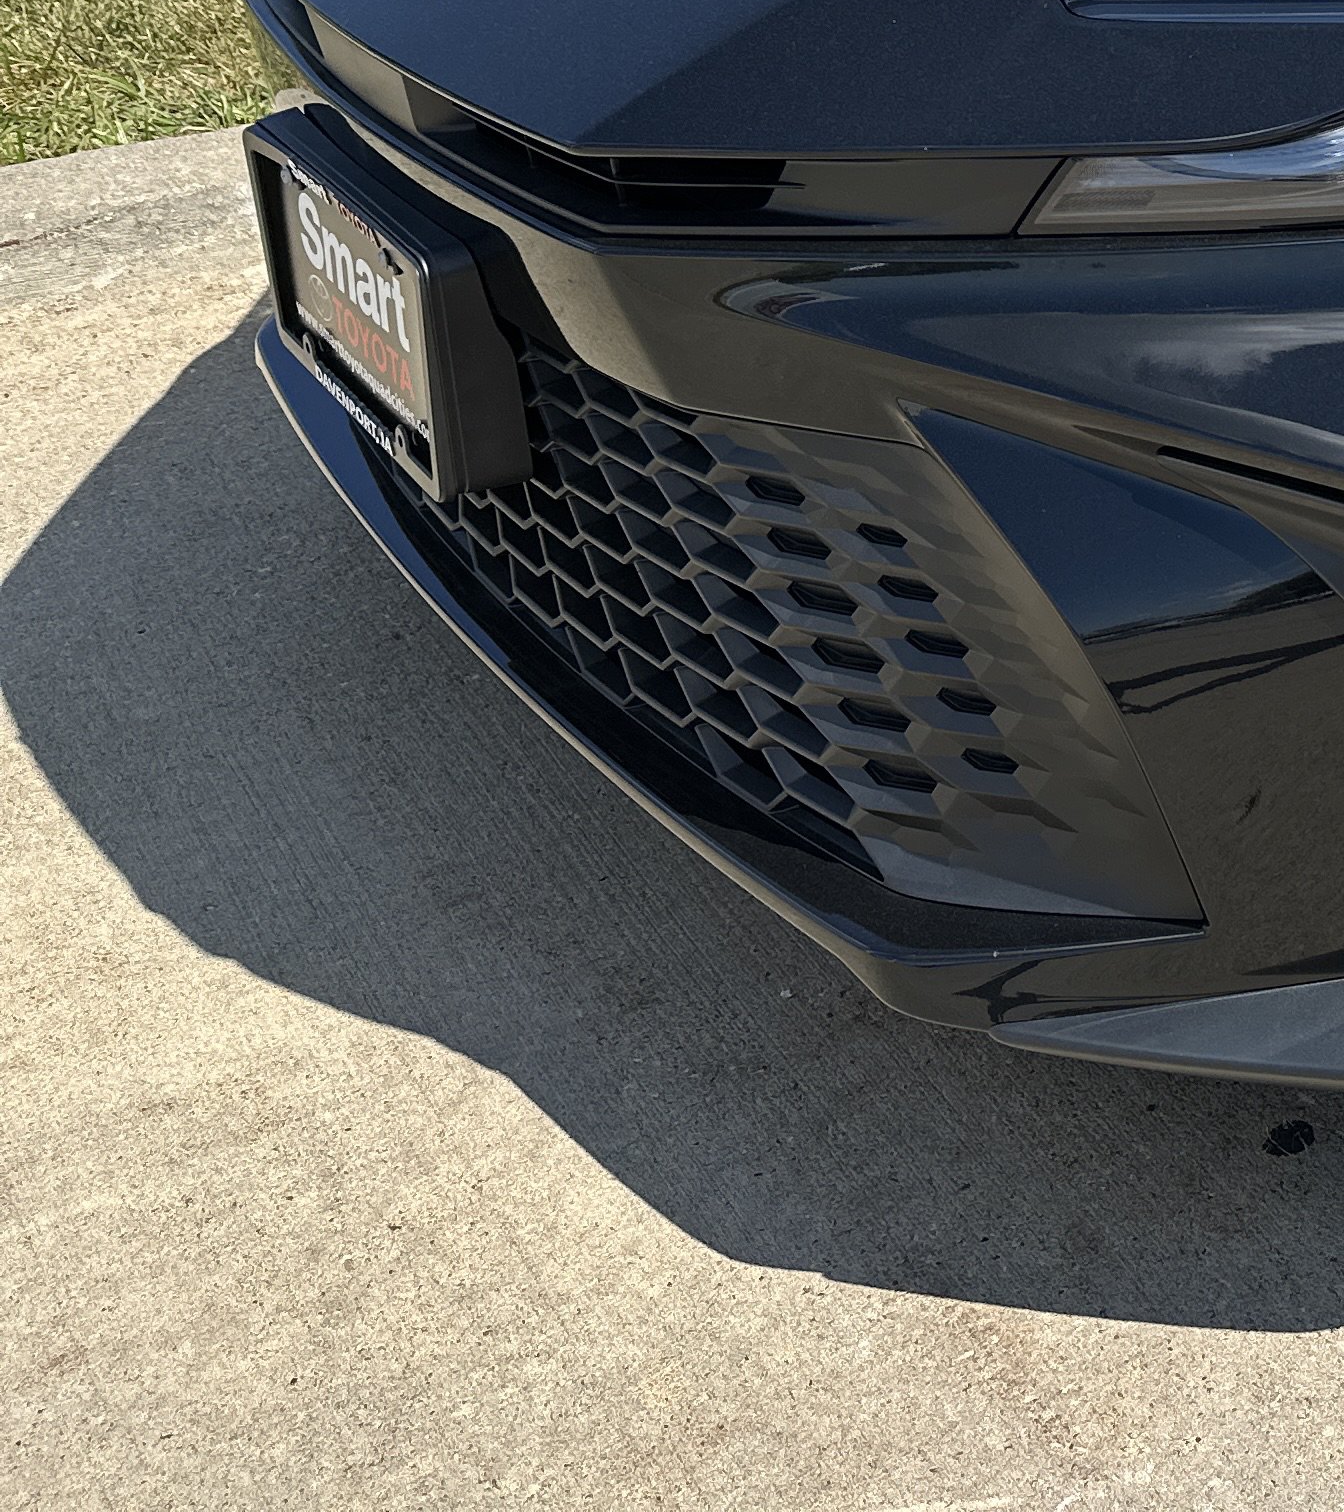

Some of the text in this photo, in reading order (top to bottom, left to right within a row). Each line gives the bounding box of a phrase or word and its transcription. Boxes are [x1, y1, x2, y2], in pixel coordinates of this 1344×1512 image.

[287, 158, 381, 248] Smart TOYOTA
[298, 192, 411, 352] Smart
[332, 295, 416, 402] TOYOTA
